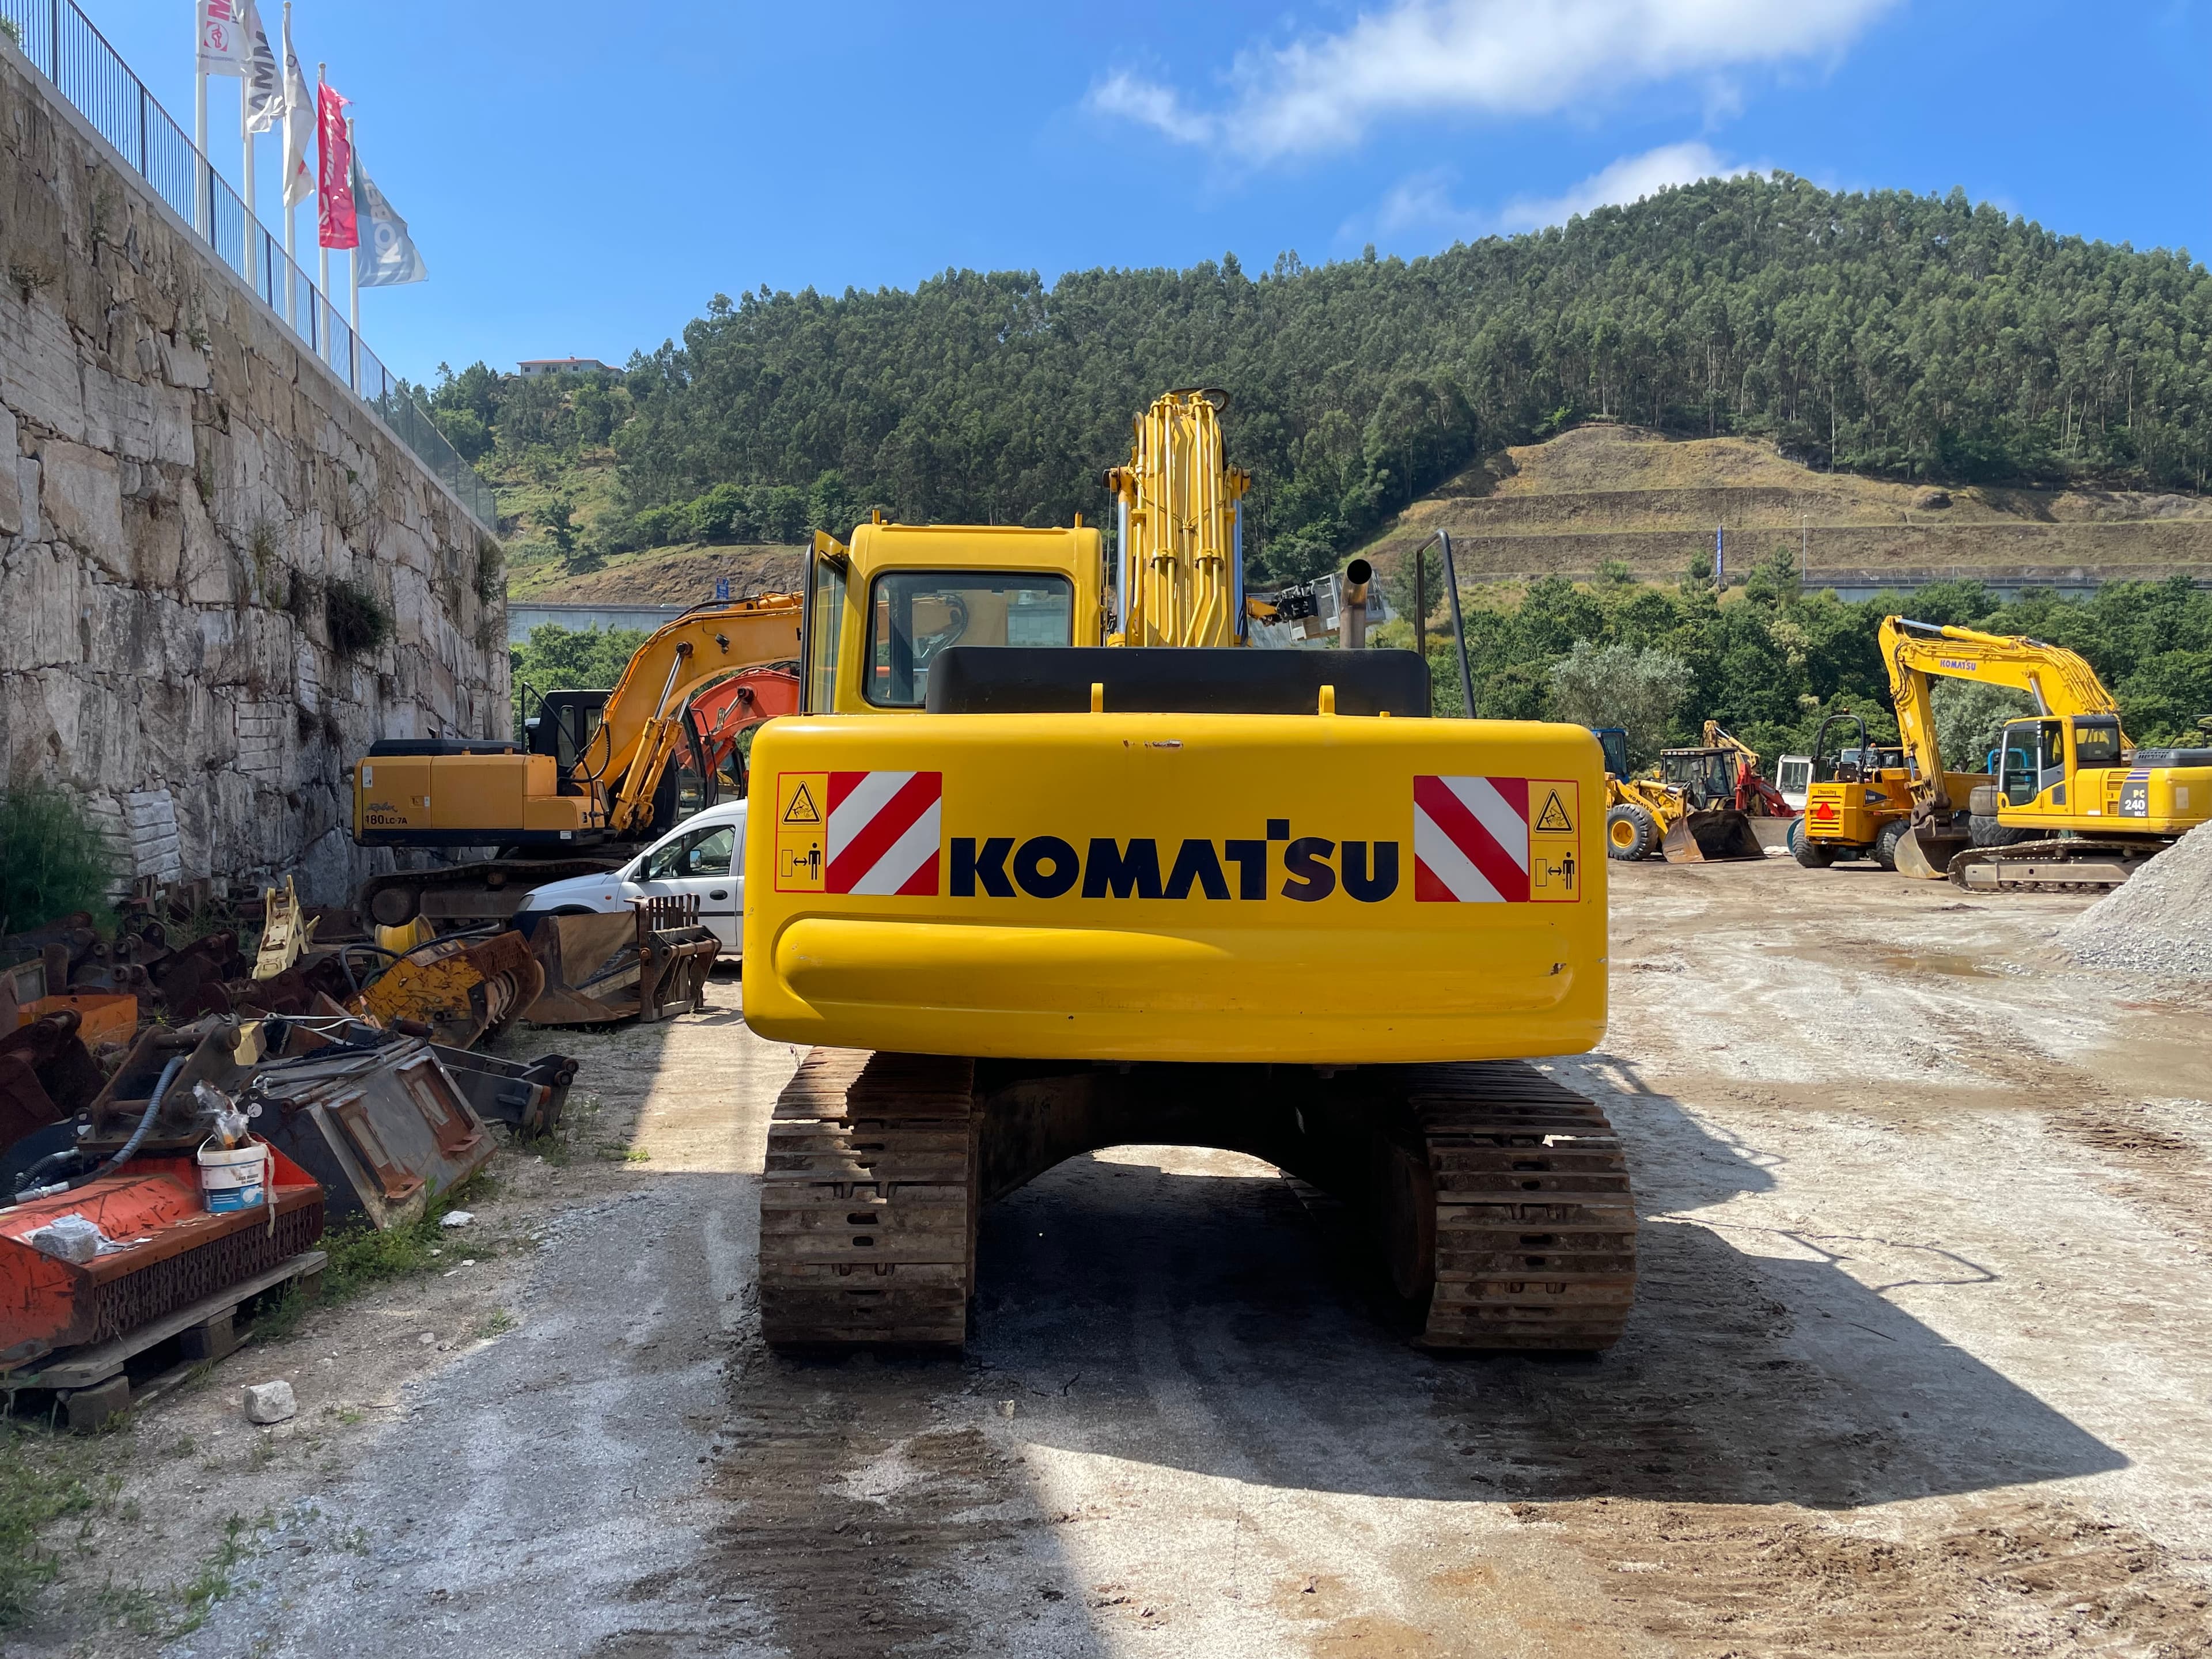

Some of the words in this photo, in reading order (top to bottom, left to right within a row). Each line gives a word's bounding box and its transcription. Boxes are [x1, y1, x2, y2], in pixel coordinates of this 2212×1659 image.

[1940, 659, 1976, 671] KOMATSU
[2133, 789, 2145, 798] PC
[1628, 793, 1654, 813] KOMATSU
[2124, 799, 2146, 810] 240
[950, 819, 1399, 903] KOMATSU
